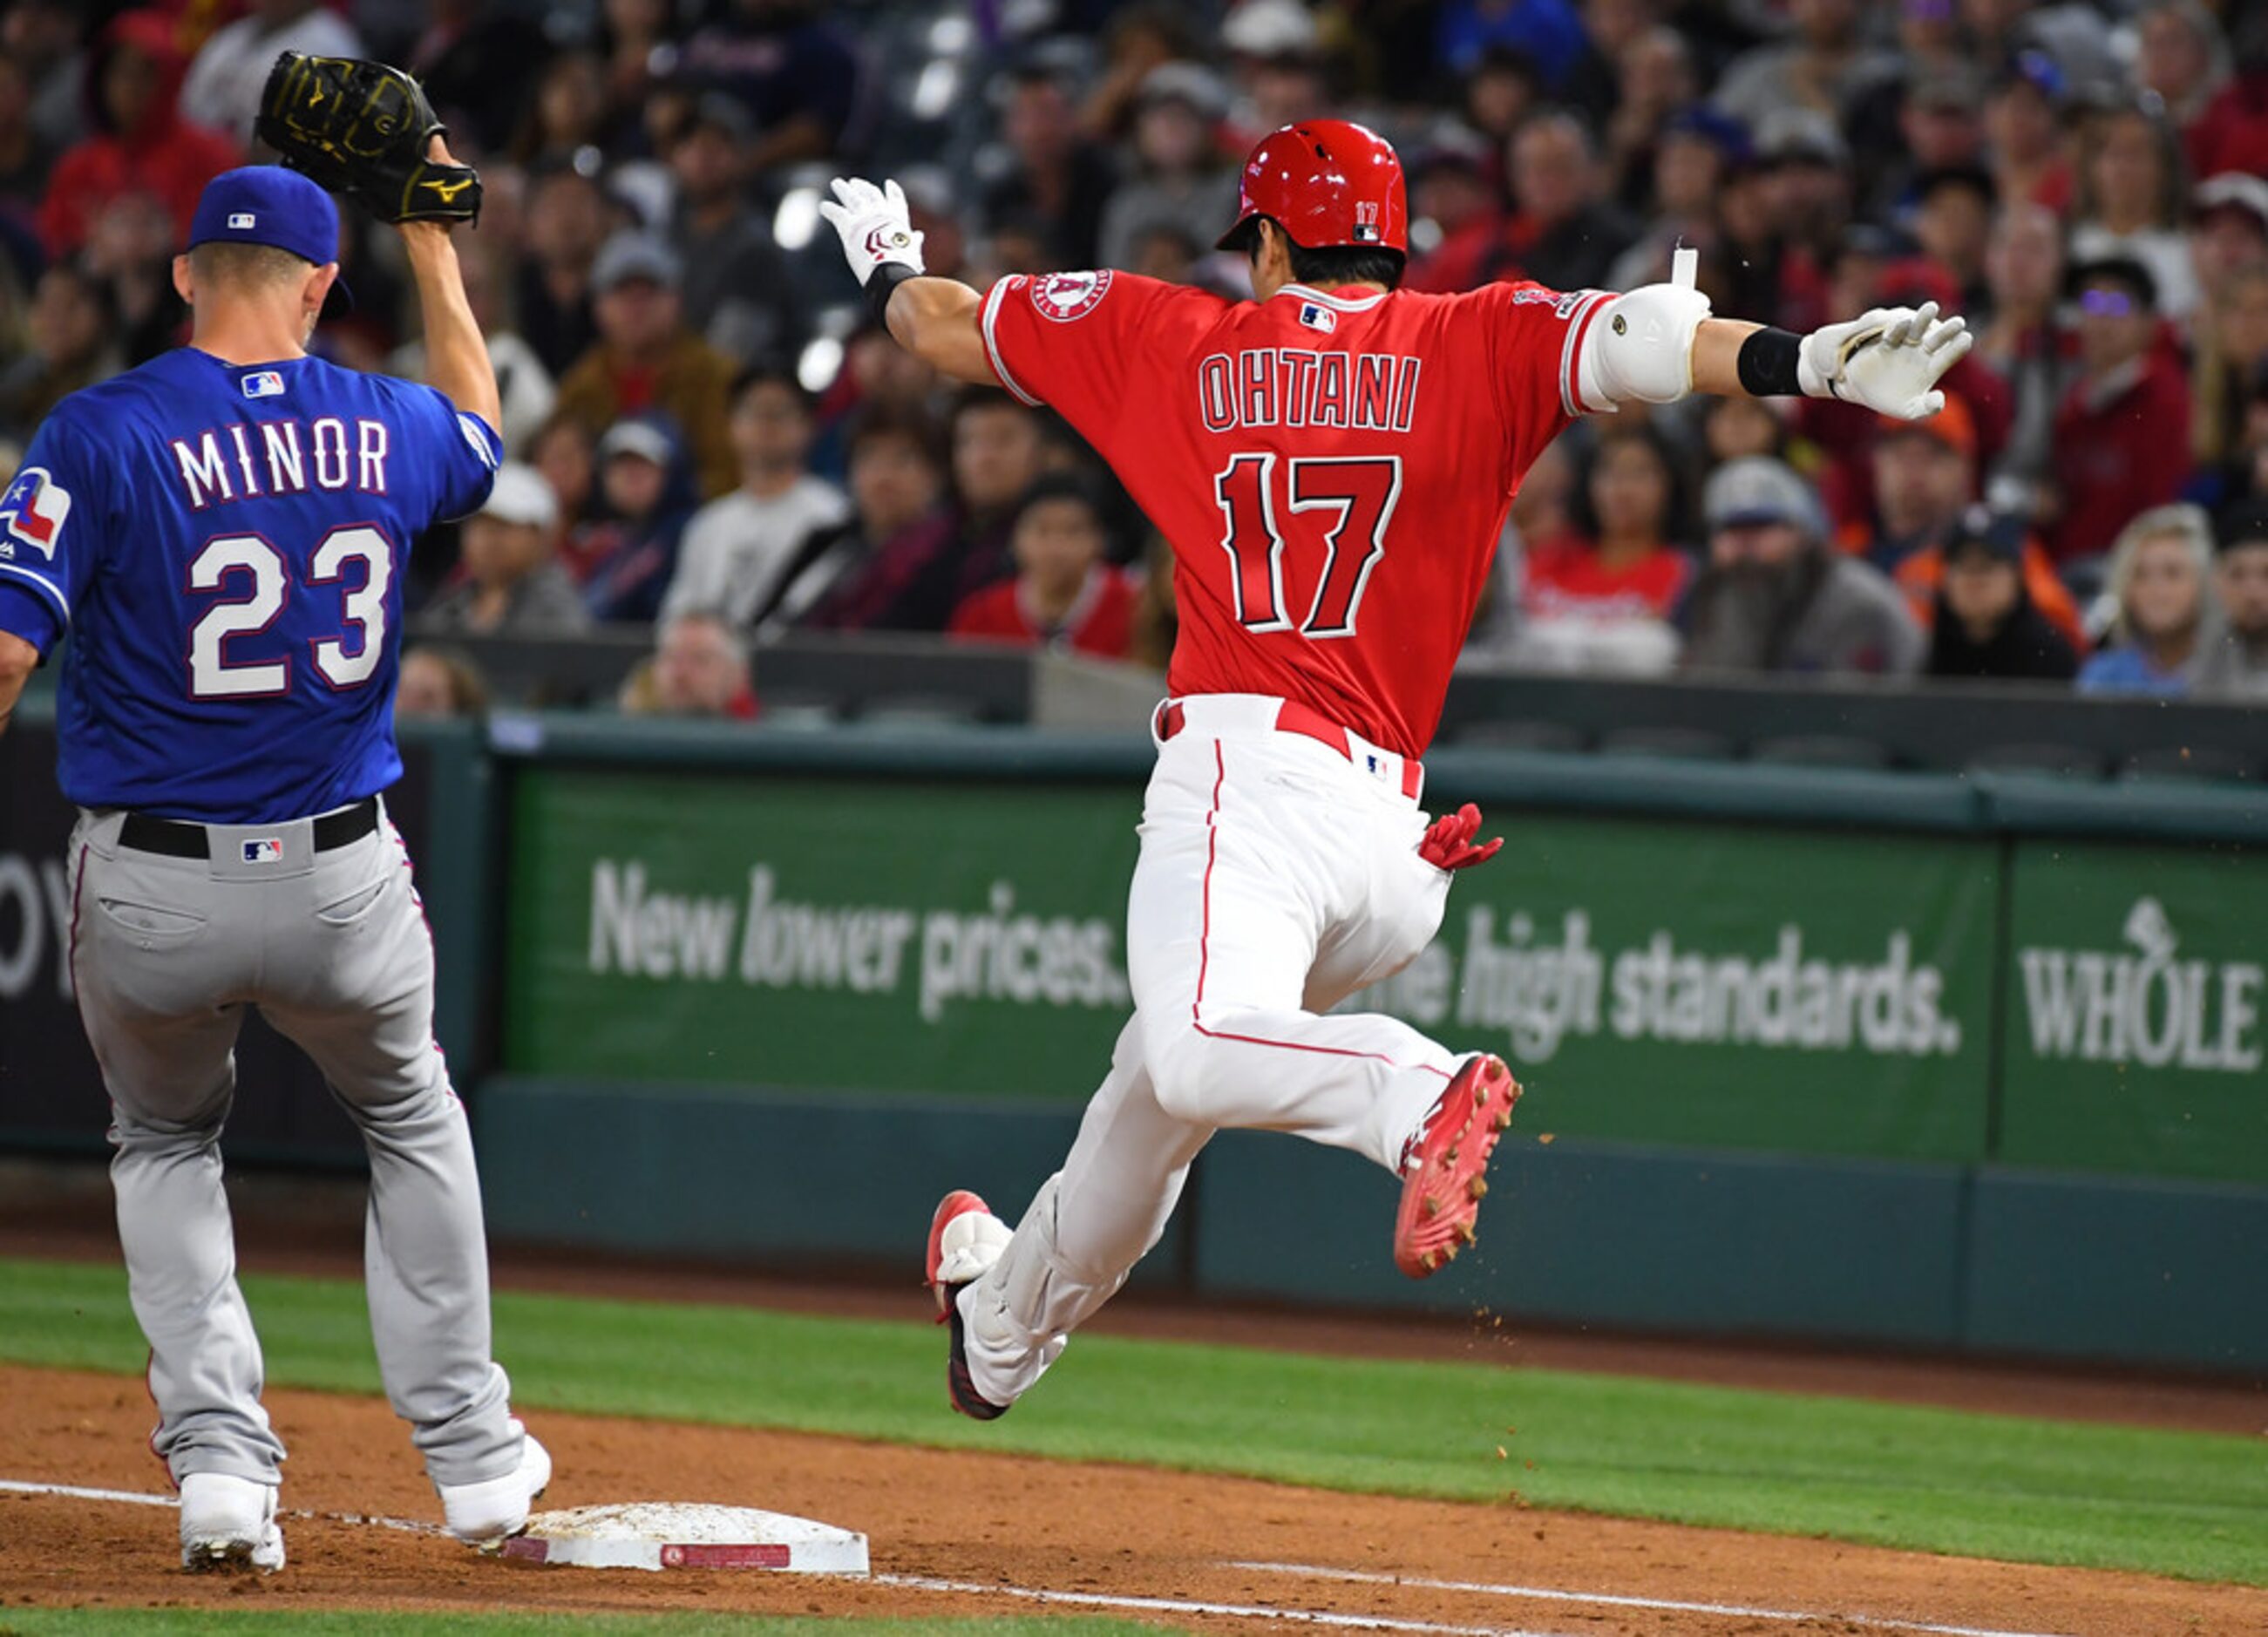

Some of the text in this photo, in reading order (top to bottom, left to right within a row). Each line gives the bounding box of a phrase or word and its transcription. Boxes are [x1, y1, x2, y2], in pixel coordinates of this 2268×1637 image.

[1355, 200, 1379, 224] 17
[1199, 348, 1422, 434] OHTANI
[170, 415, 390, 512] MINOR
[1214, 452, 1402, 639] 17
[184, 520, 396, 701] 23
[589, 858, 737, 979] New
[740, 861, 912, 994] lower
[1457, 904, 1601, 1063] high
[1612, 922, 1961, 1056] standards.
[2019, 946, 2265, 1072] WHOLE
